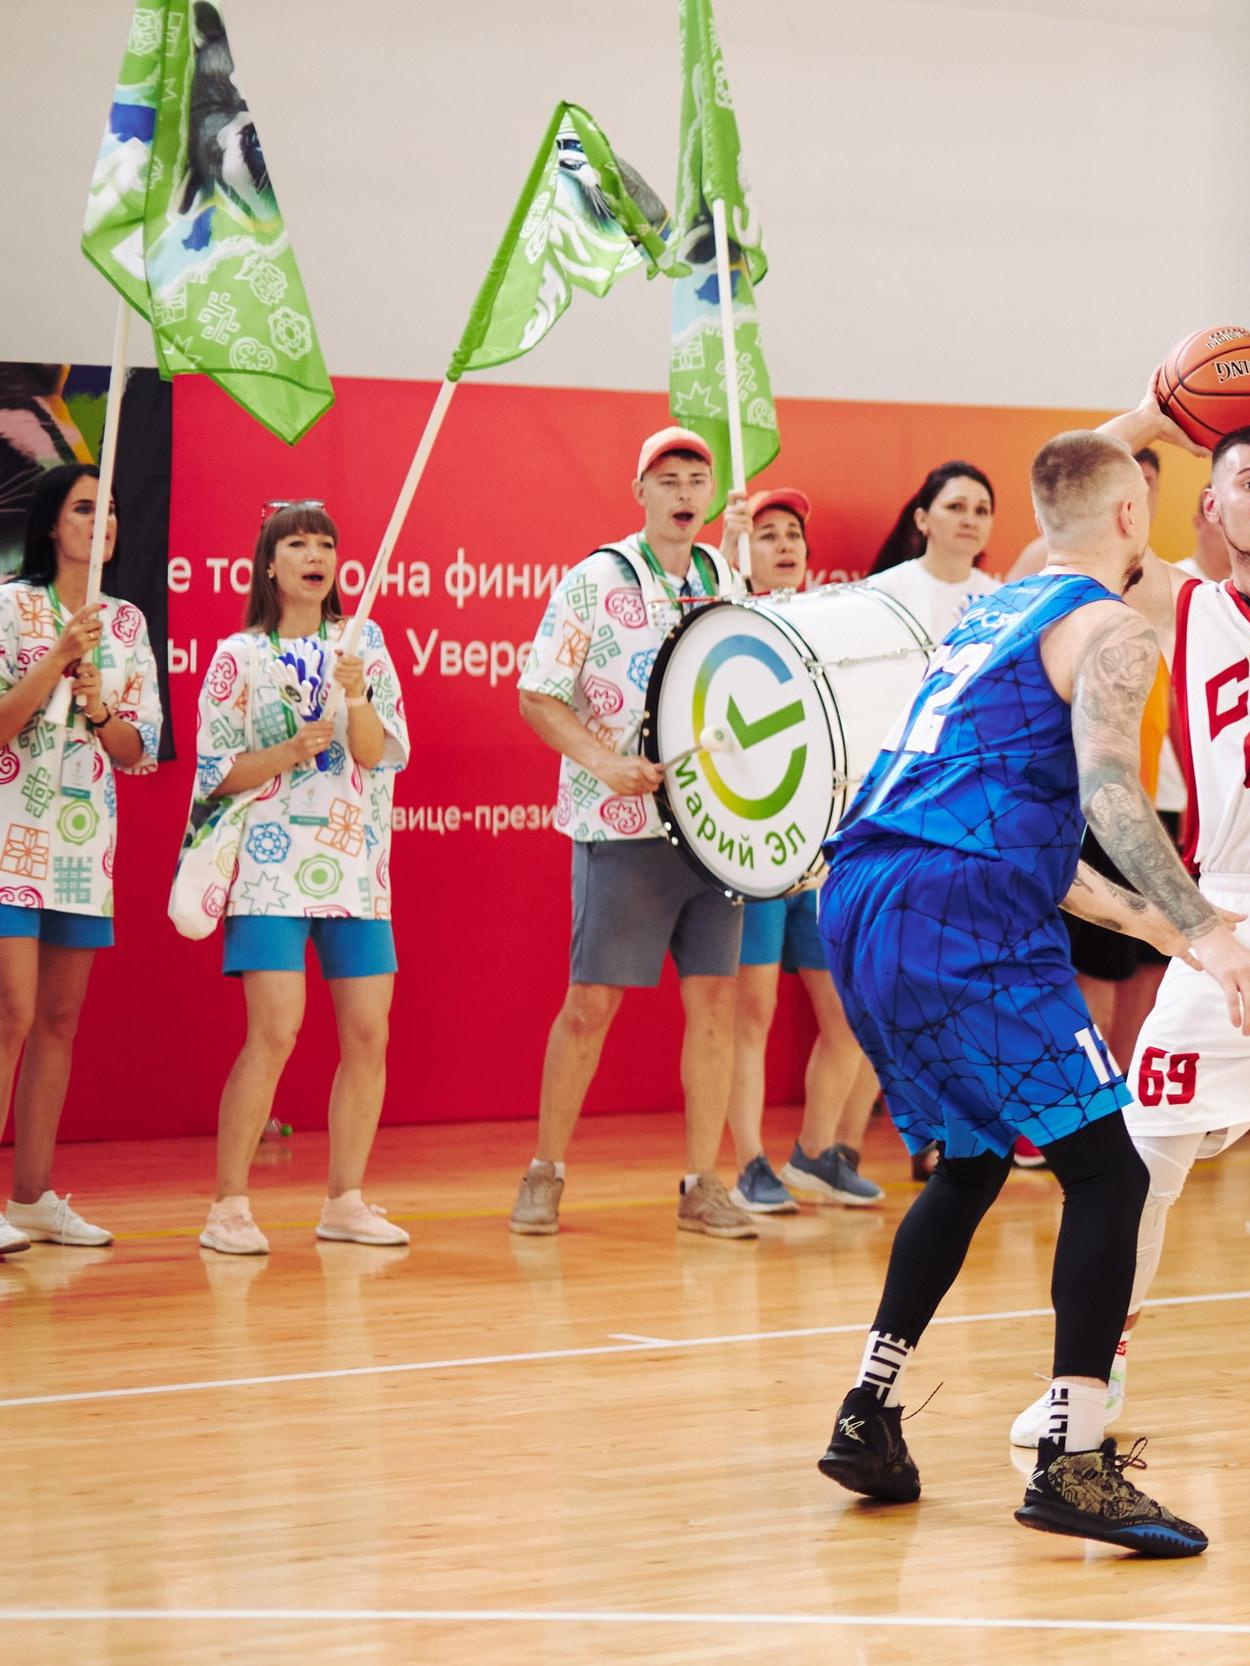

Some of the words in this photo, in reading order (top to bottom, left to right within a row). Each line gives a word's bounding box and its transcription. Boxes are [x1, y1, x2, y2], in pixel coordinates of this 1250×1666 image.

[380, 561, 431, 598] на
[444, 547, 570, 609] фини
[764, 821, 807, 867] Эл
[1138, 1045, 1200, 1107] 69
